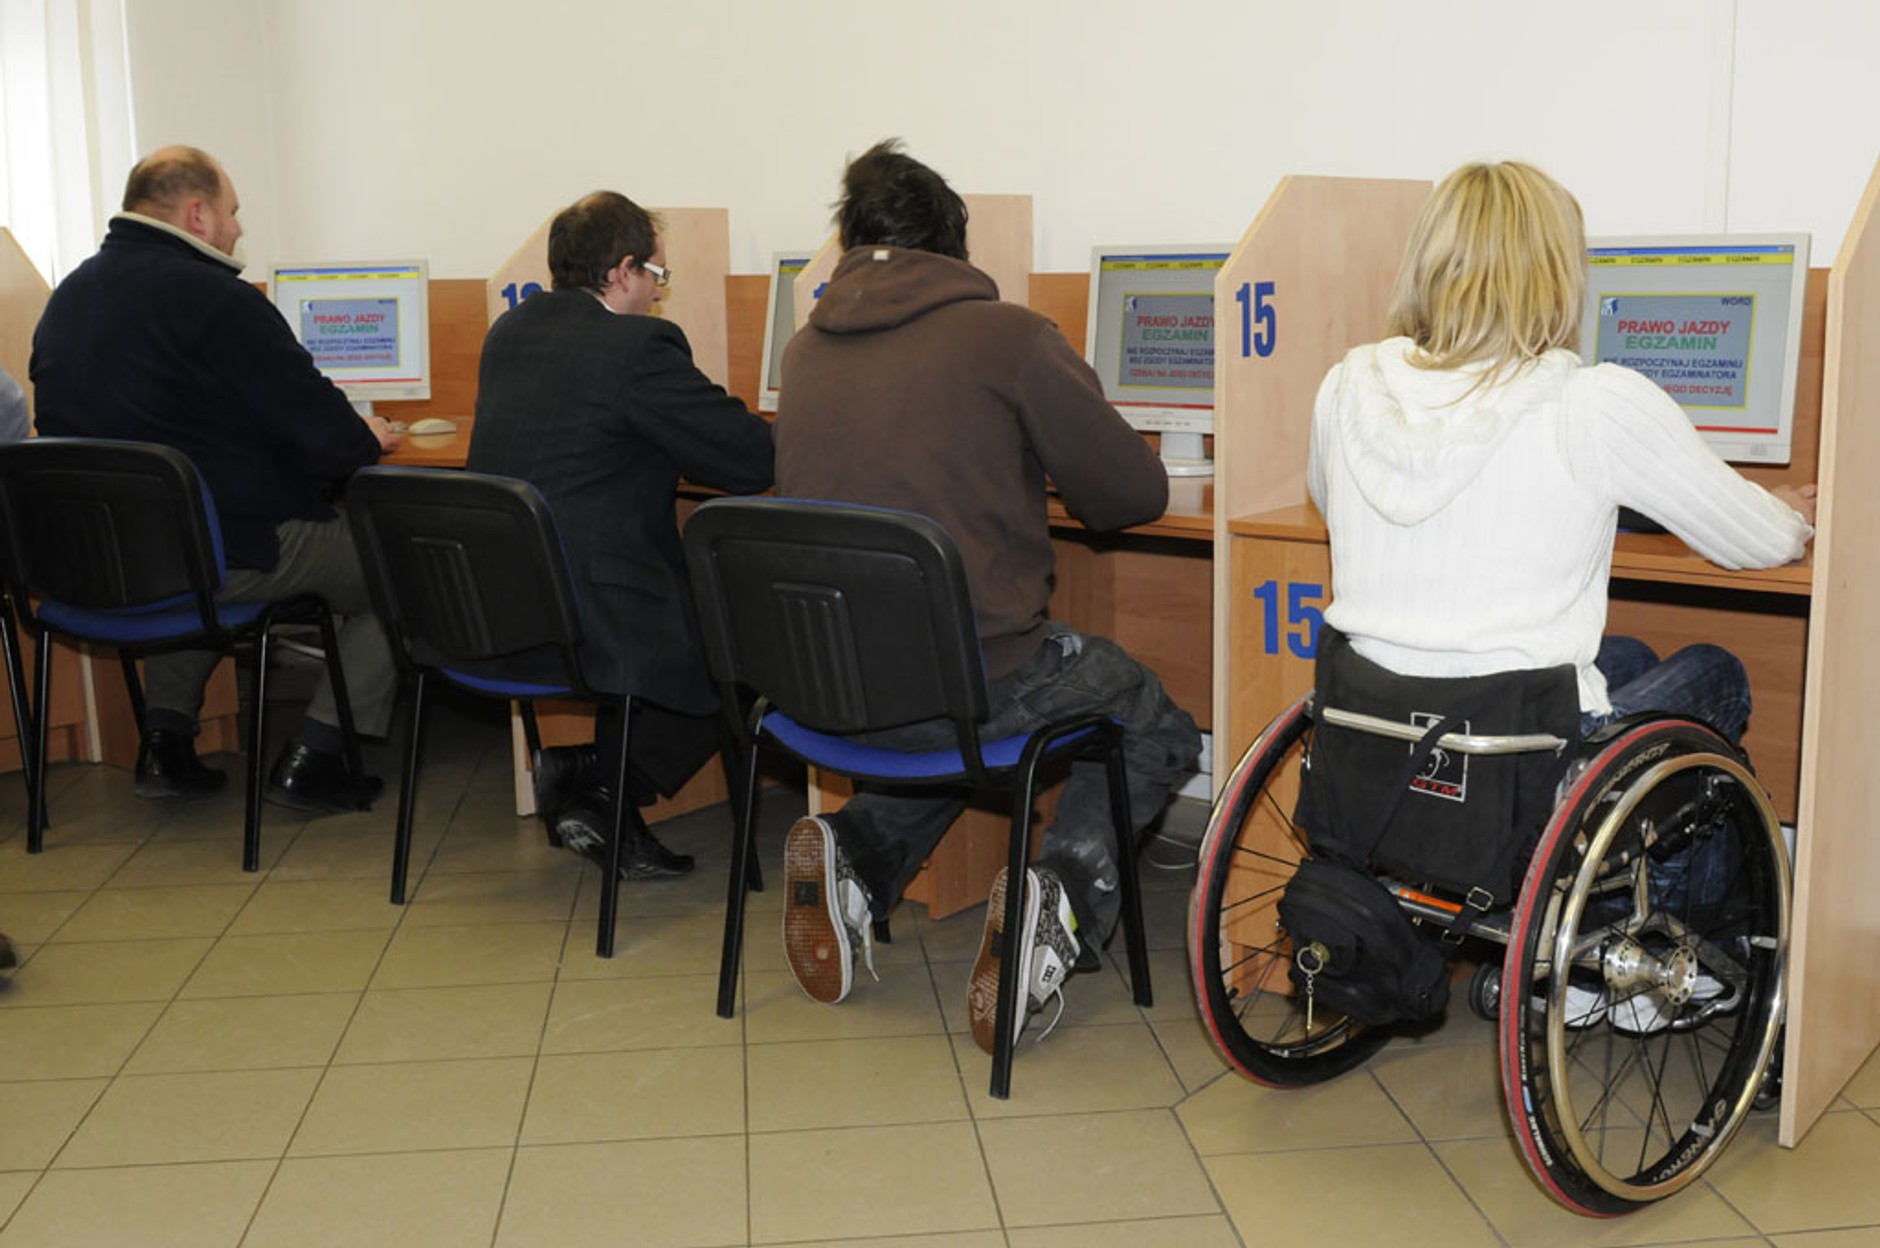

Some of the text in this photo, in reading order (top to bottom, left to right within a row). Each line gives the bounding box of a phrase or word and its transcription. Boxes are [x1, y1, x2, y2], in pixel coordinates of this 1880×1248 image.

[1721, 297, 1751, 307] WORD
[1136, 315, 1178, 328] PRAWO
[1235, 281, 1276, 358] 15
[319, 323, 380, 335] EGZAMIN
[1618, 320, 1731, 335] PRAWO JAZDY
[1142, 329, 1209, 342] EGZAMIN
[1624, 335, 1718, 351] EGZAMIN
[1691, 358, 1743, 369] EGZAMINU
[1661, 369, 1737, 380] EGZAMINATORA
[1253, 580, 1324, 660] 15
